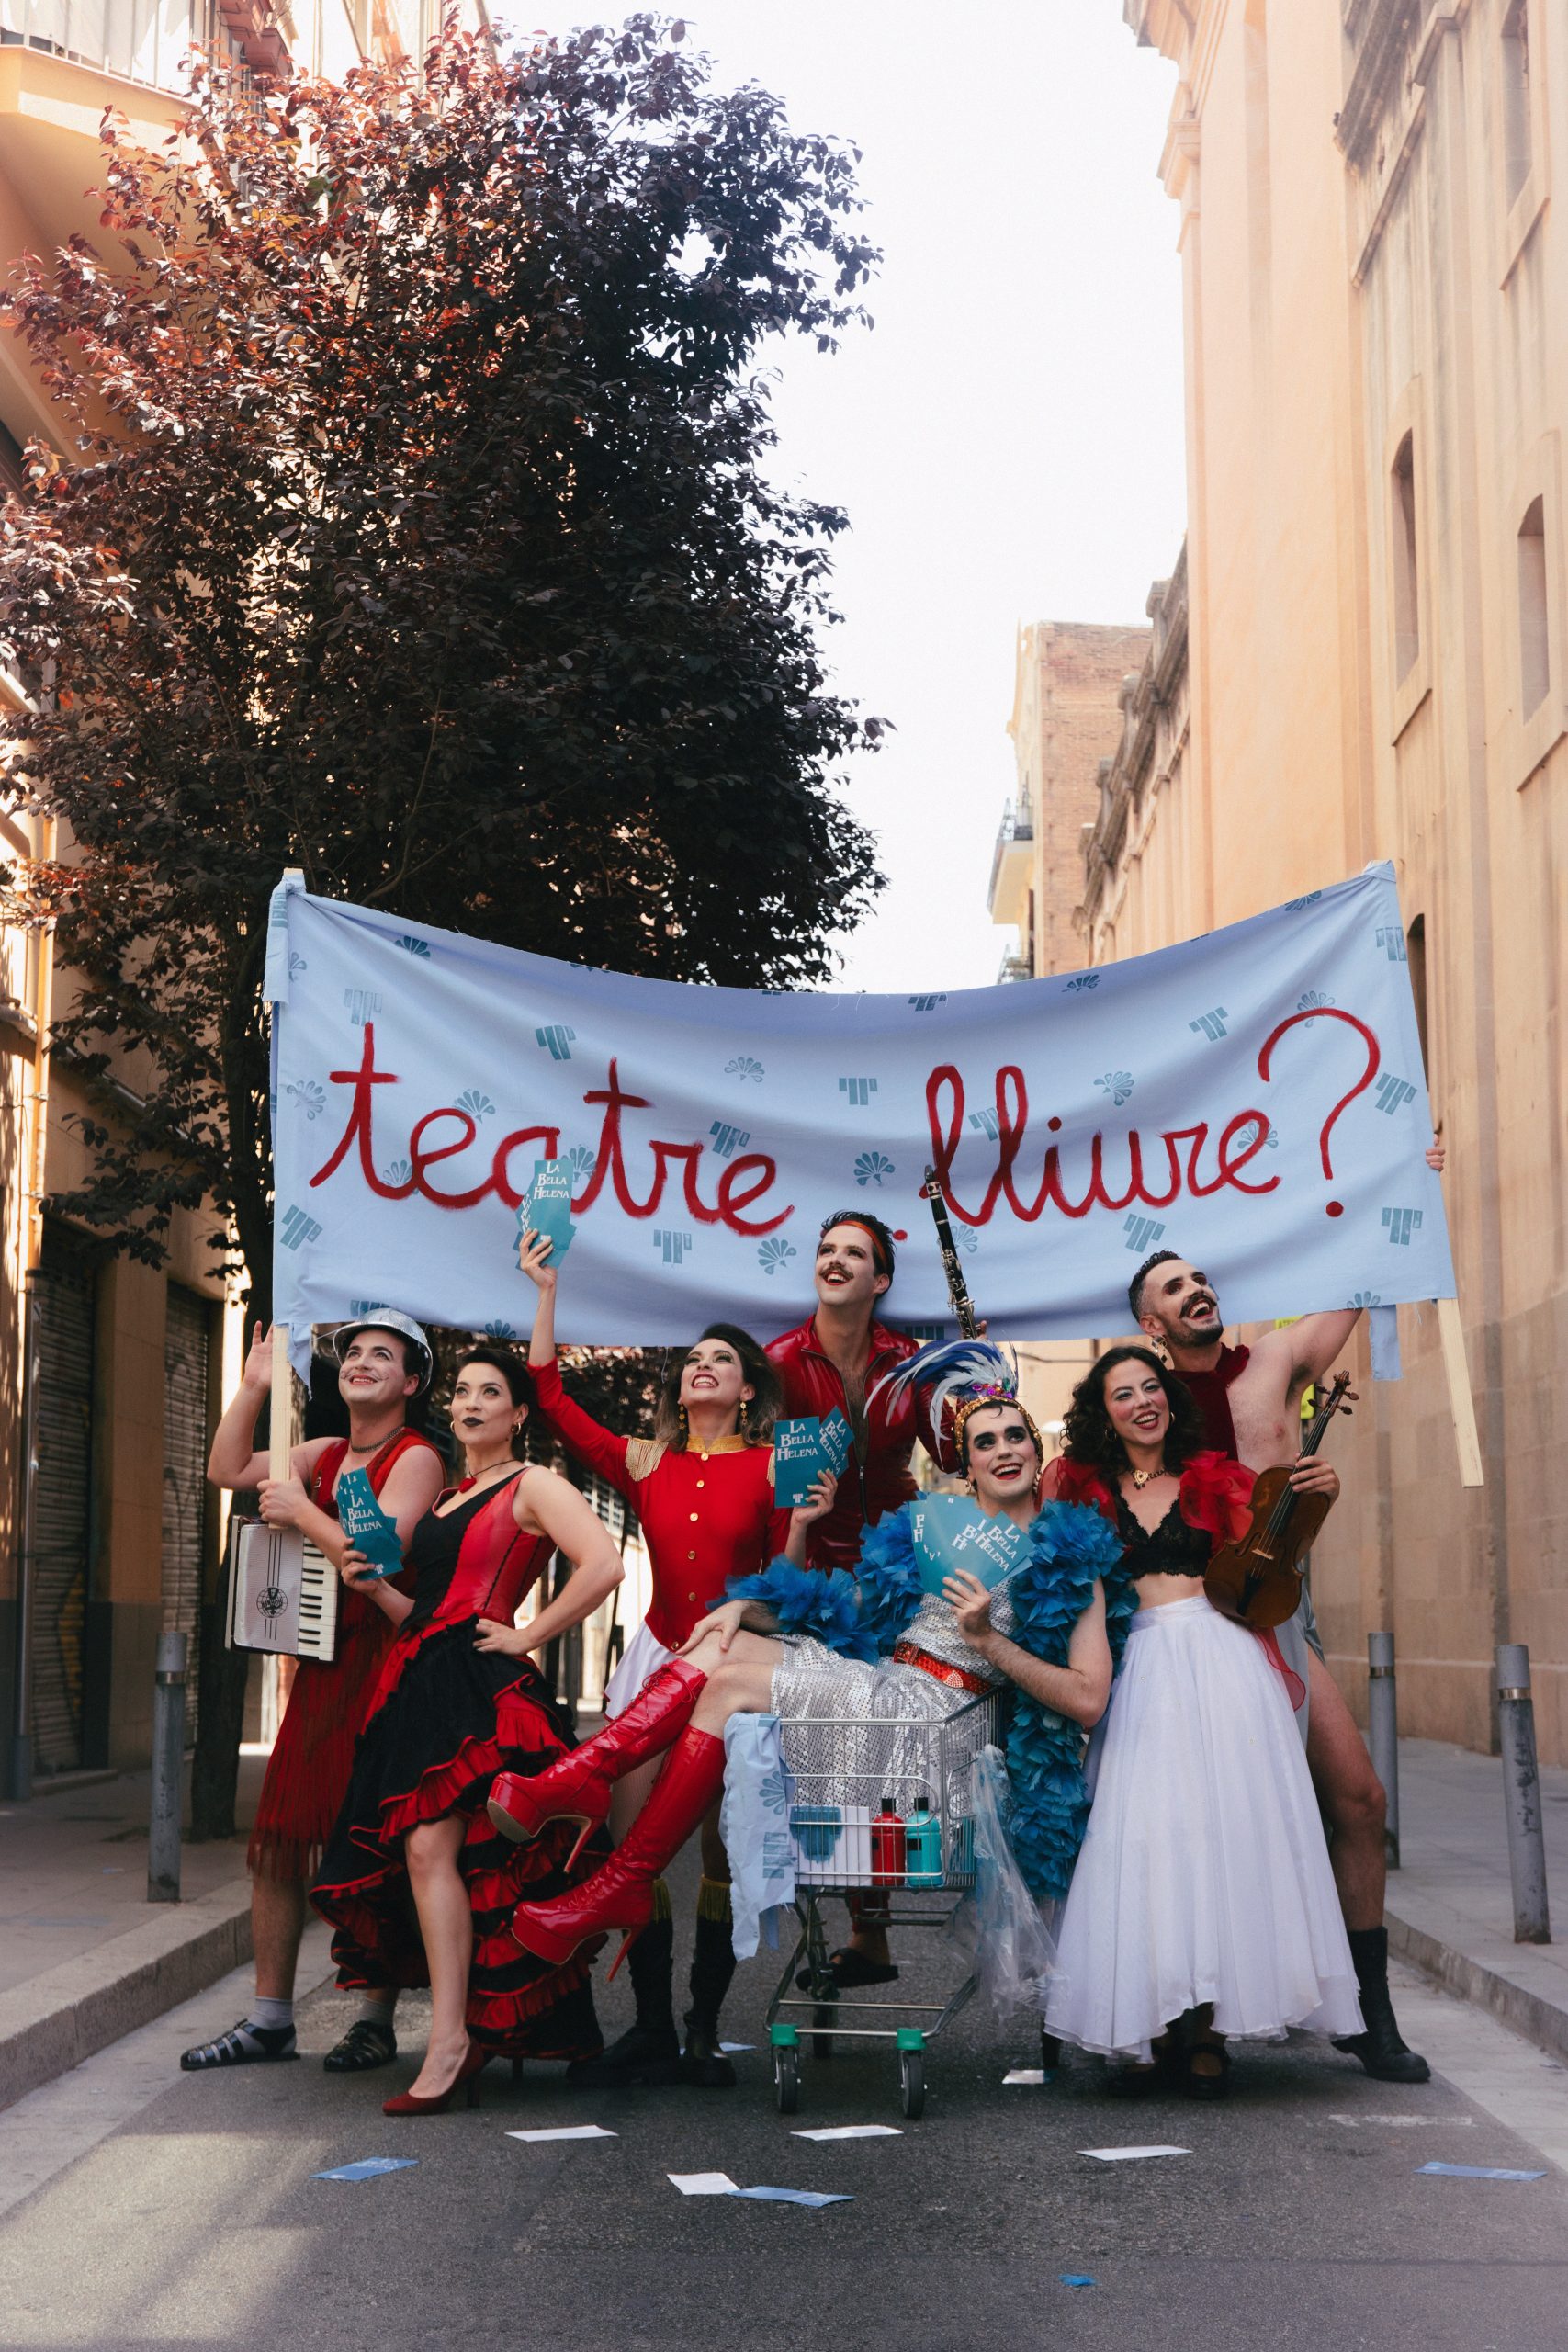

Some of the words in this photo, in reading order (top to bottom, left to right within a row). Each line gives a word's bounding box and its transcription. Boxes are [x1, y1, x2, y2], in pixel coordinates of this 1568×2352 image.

[309, 1022, 795, 1237] teatre
[537, 1173, 567, 1186] BELLA
[533, 1186, 570, 1200] HELENA
[780, 1434, 815, 1448] BELLA
[777, 1447, 818, 1461] HELENA
[347, 1508, 375, 1521] BELLA
[348, 1521, 382, 1535] HELENA
[975, 1532, 1010, 1571] HELENA
